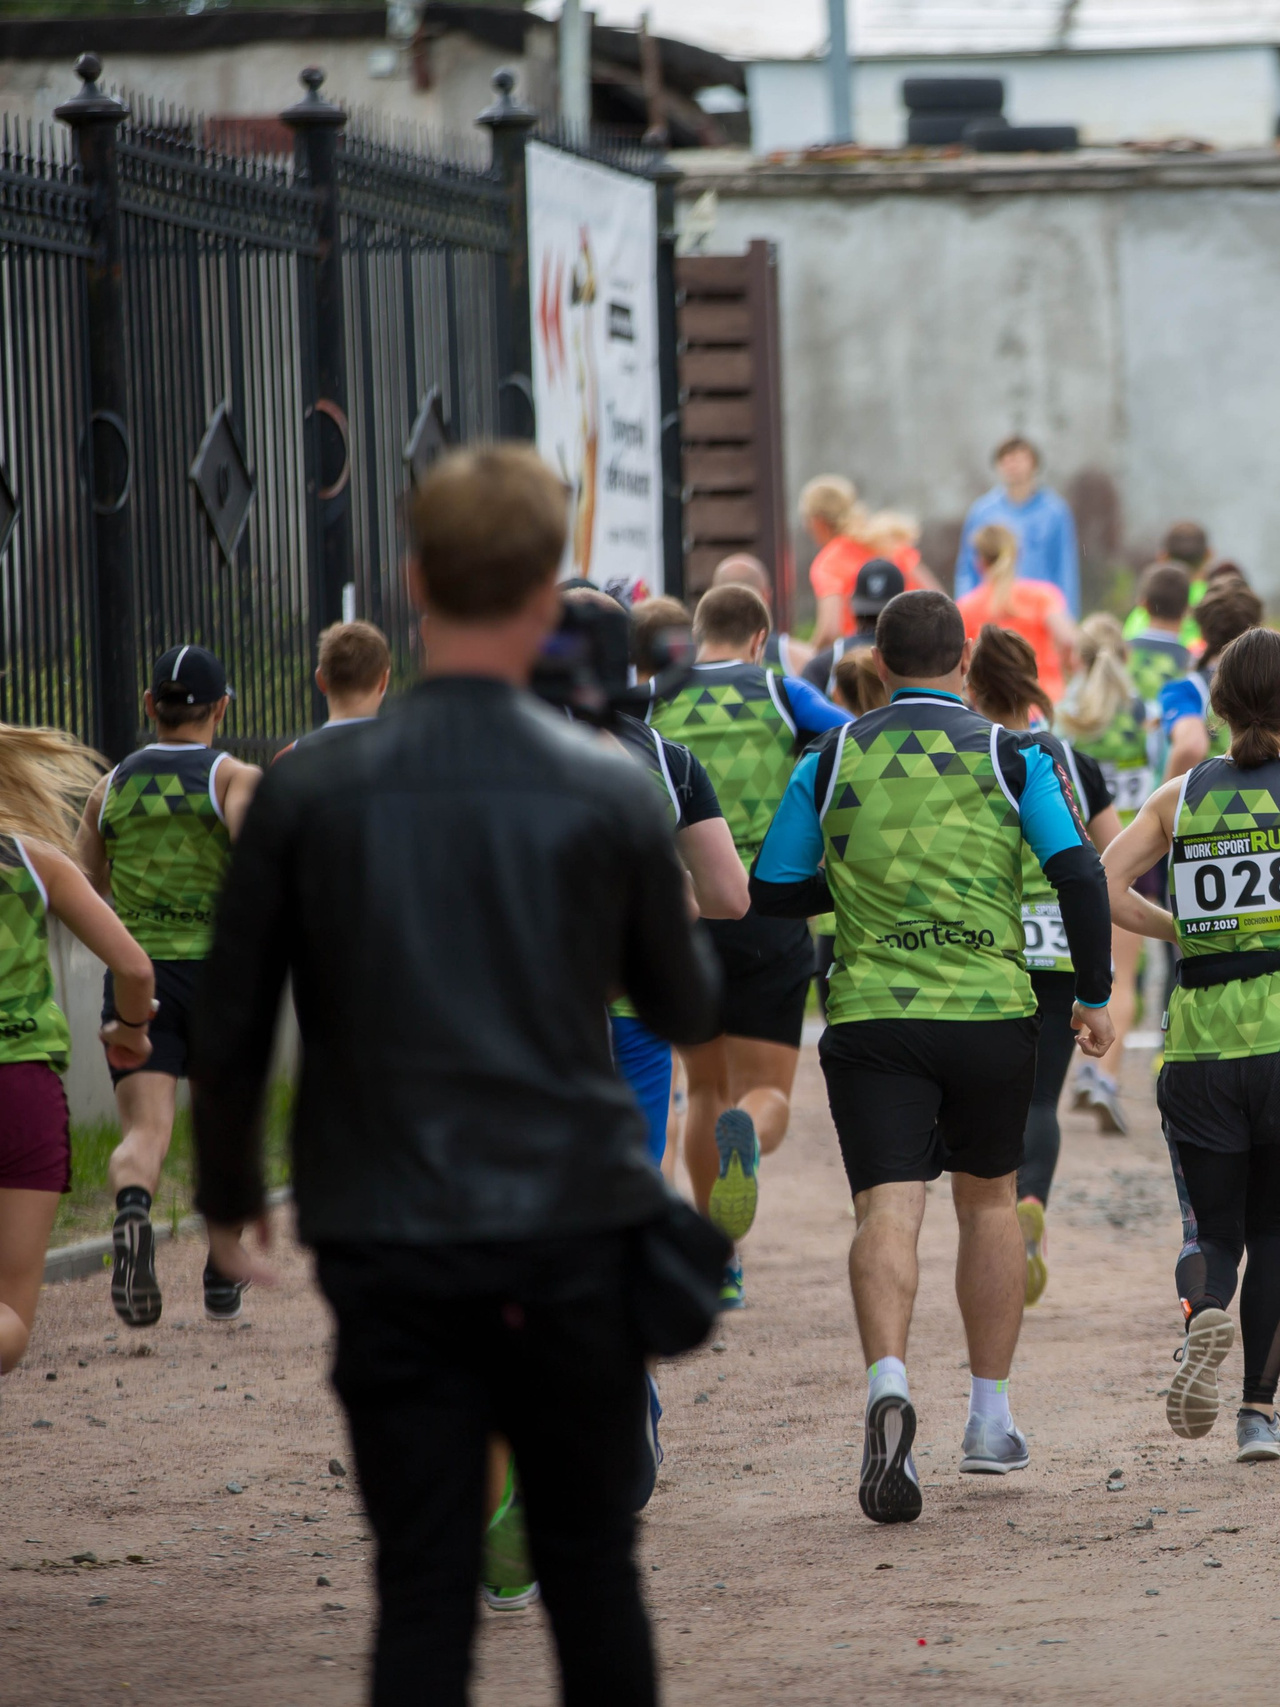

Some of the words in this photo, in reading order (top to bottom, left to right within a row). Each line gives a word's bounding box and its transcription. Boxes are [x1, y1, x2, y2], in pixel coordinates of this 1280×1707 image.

[1183, 838, 1250, 859] WORK&SPORT
[1186, 918, 1238, 934] 14.07.2019
[1244, 915, 1274, 926] СОСНОВКА
